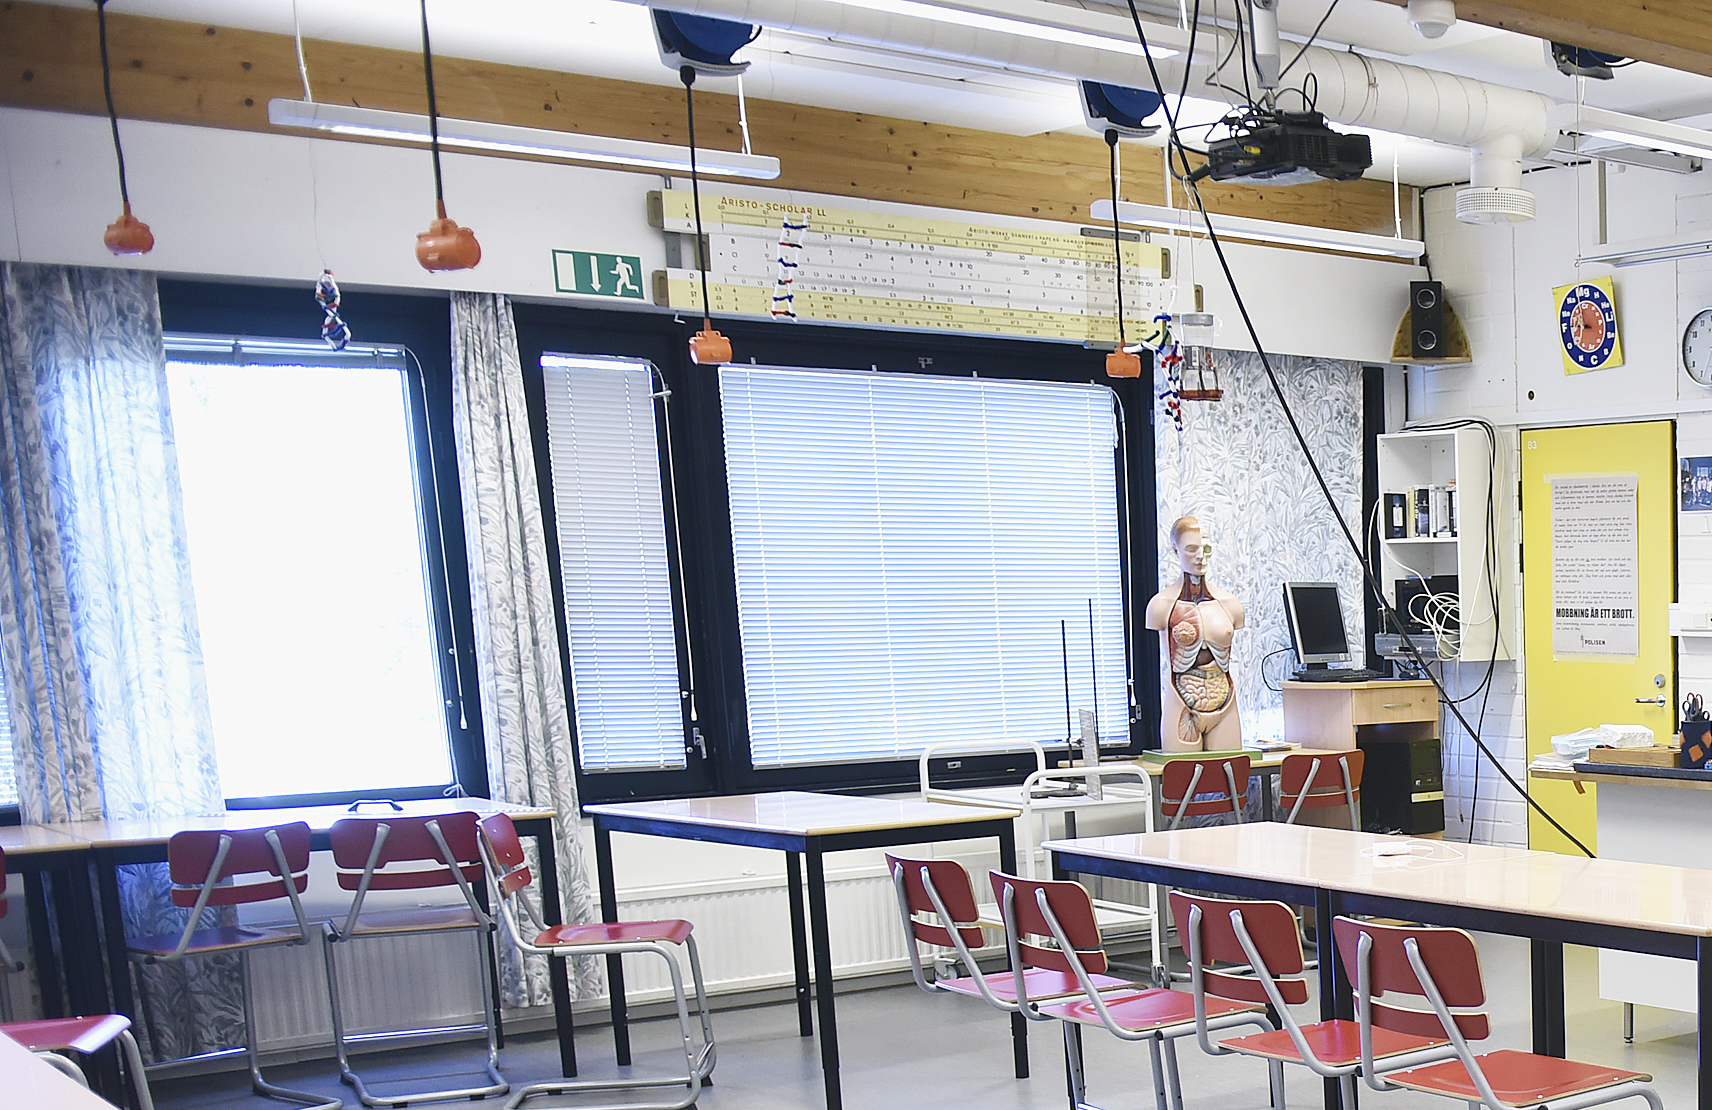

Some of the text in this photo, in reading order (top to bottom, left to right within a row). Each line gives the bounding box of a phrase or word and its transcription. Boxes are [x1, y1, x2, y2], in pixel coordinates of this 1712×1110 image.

[1561, 323, 1568, 333] F
[1590, 355, 1598, 365] C
[1527, 440, 1537, 450] 83
[1555, 607, 1635, 619] MOBBNING ÄR ETT BROTT.
